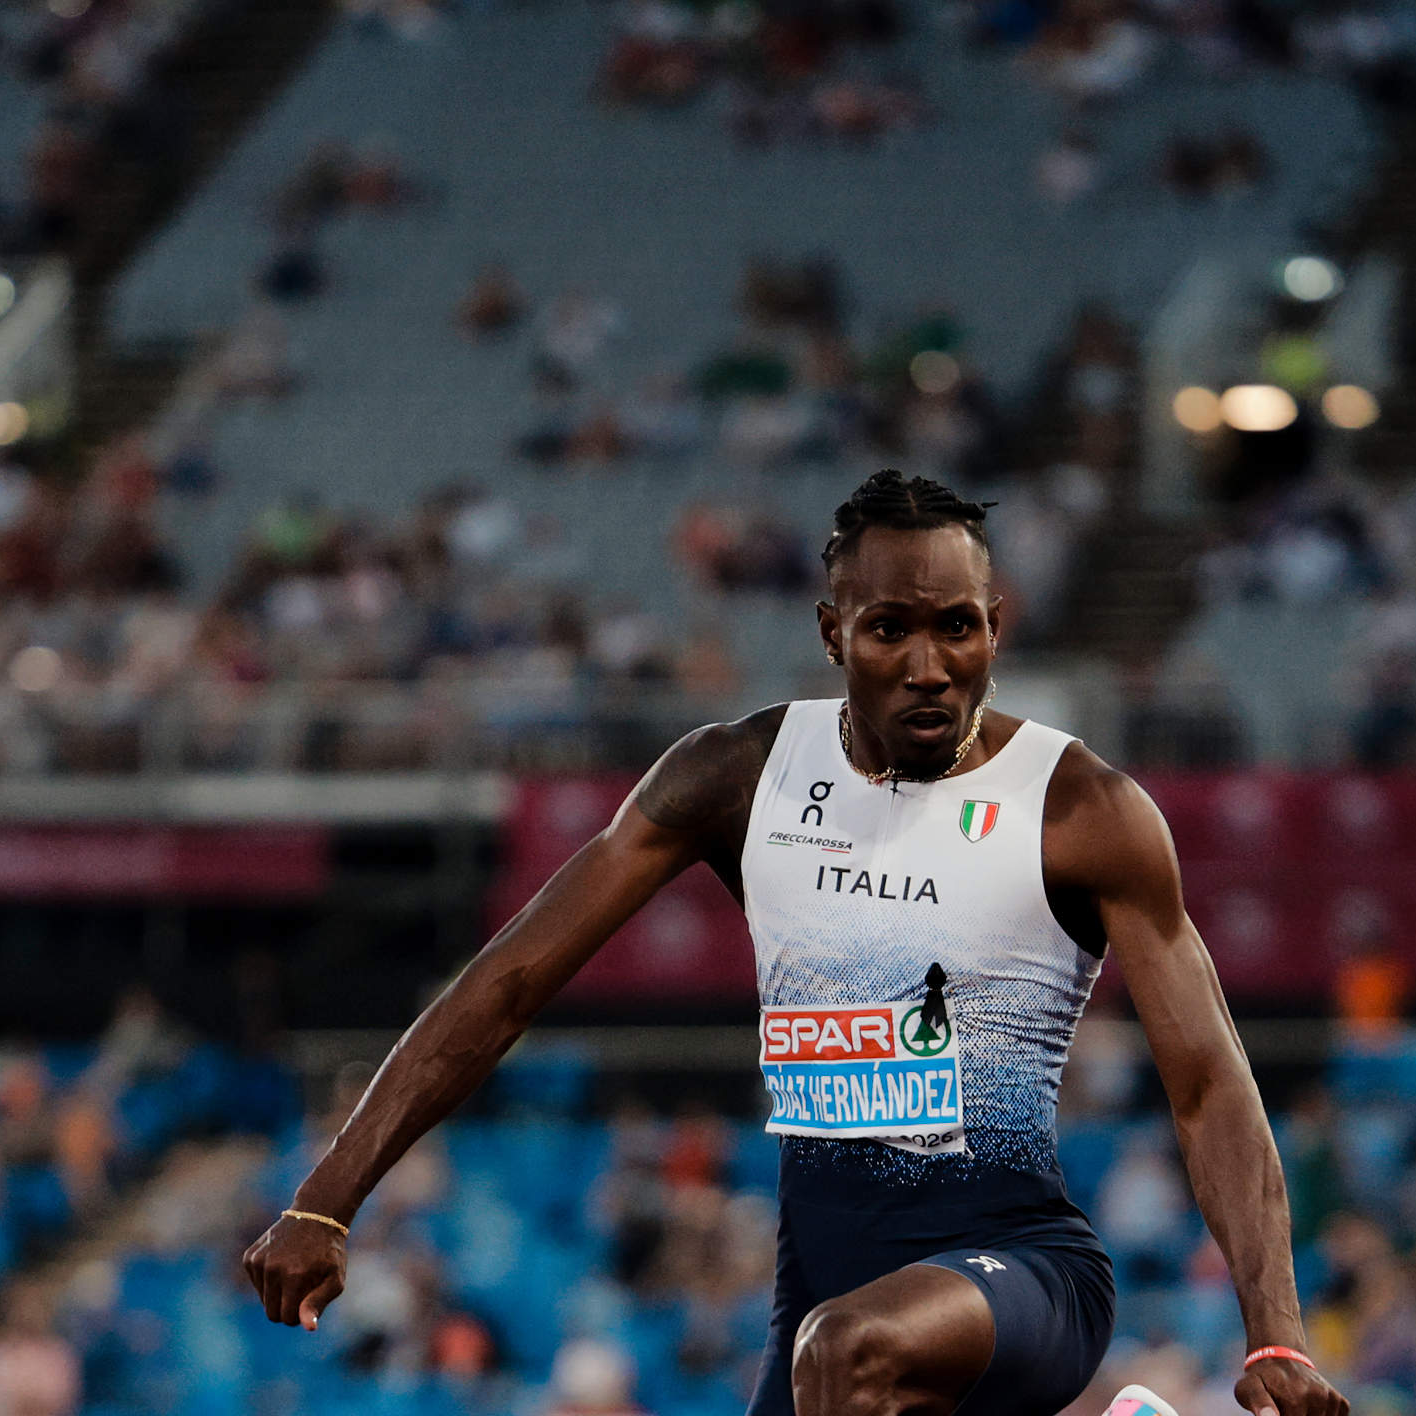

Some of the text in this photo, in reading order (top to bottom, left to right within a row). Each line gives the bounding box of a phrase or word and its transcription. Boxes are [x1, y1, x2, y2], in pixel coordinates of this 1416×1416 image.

[768, 831, 853, 850] FRECCIAROSSA
[816, 865, 939, 905] ITALIA
[766, 1015, 891, 1055] SPAR
[809, 1061, 957, 1123] HERNÁNDEZ
